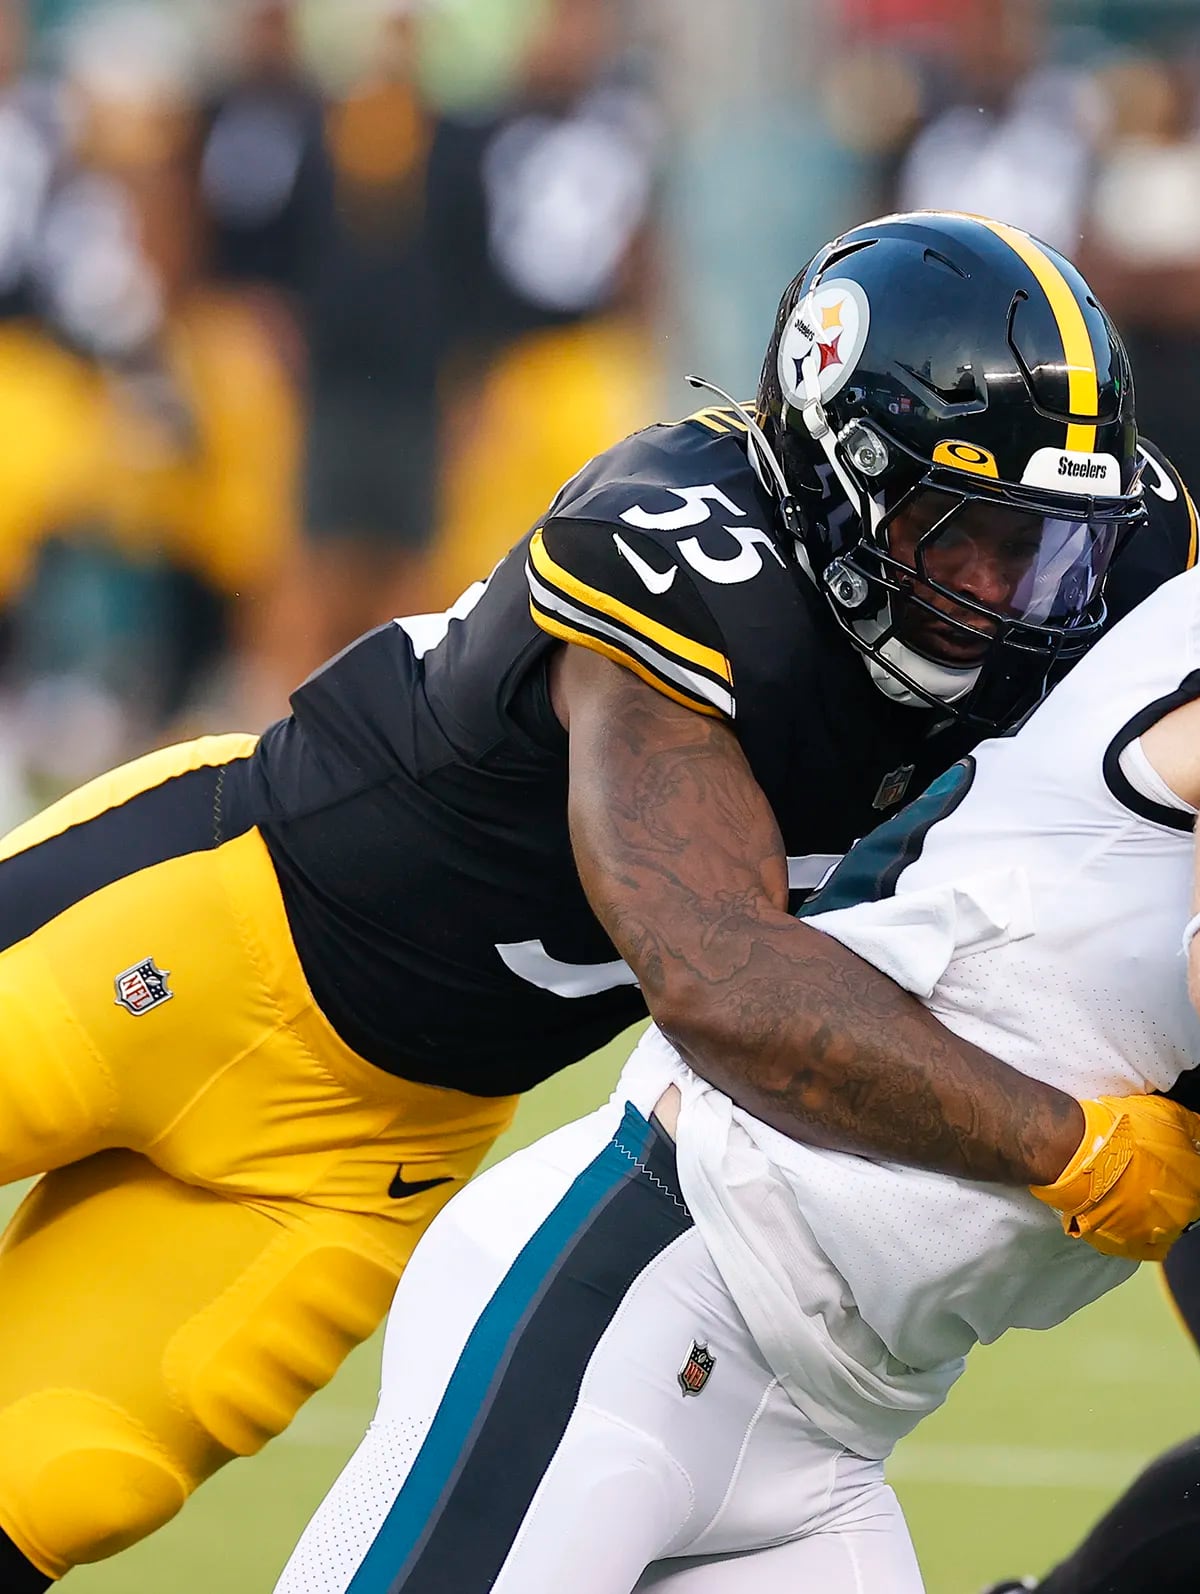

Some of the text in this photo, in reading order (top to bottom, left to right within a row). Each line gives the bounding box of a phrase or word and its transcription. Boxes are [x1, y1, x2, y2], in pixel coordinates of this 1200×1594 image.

[1057, 455, 1107, 479] Steelers
[619, 483, 787, 584] 55
[123, 974, 150, 1009] NFL
